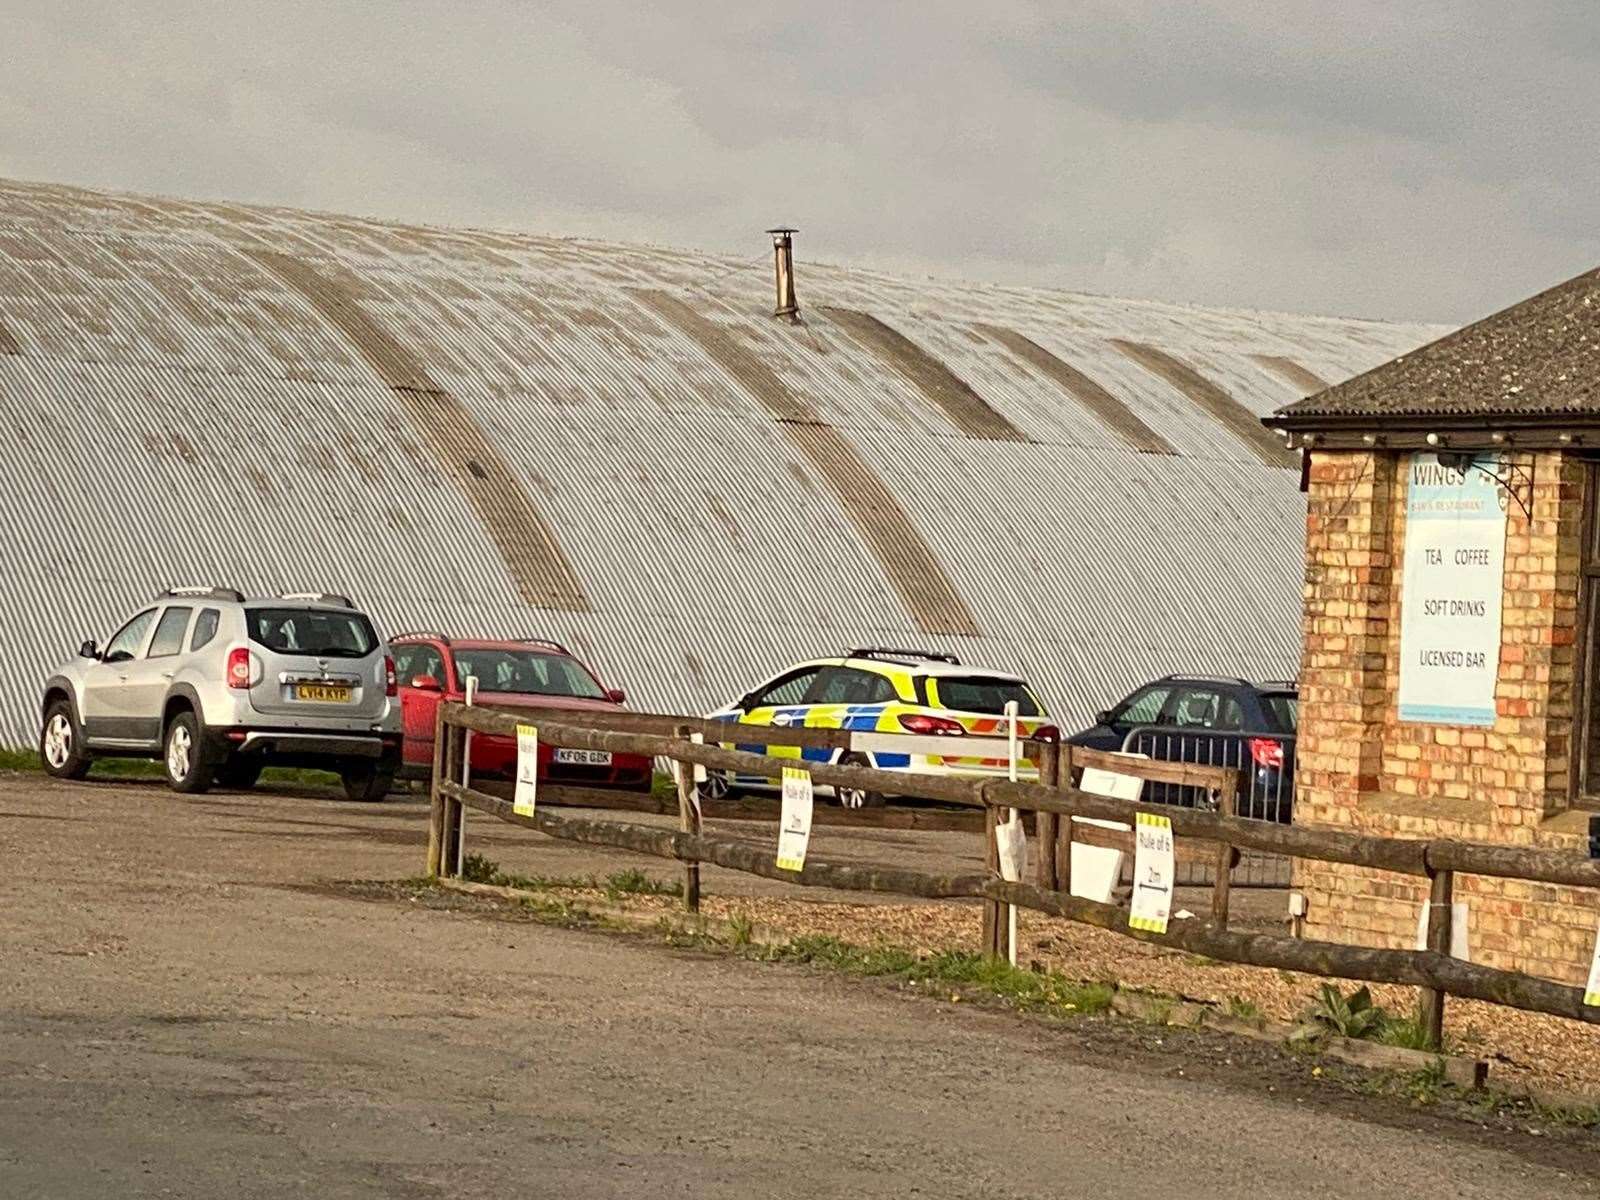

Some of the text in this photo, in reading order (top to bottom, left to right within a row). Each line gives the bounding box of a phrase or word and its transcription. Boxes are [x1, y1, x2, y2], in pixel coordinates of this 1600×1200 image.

[1414, 465, 1465, 486] WINGS
[1425, 549, 1489, 565] TEA COFFEE
[1424, 600, 1485, 616] SOFT DRINKS
[1420, 650, 1485, 668] LICENSED BAR
[1139, 832, 1155, 850] Rule
[1156, 834, 1164, 851] of
[1148, 866, 1161, 883] 2m
